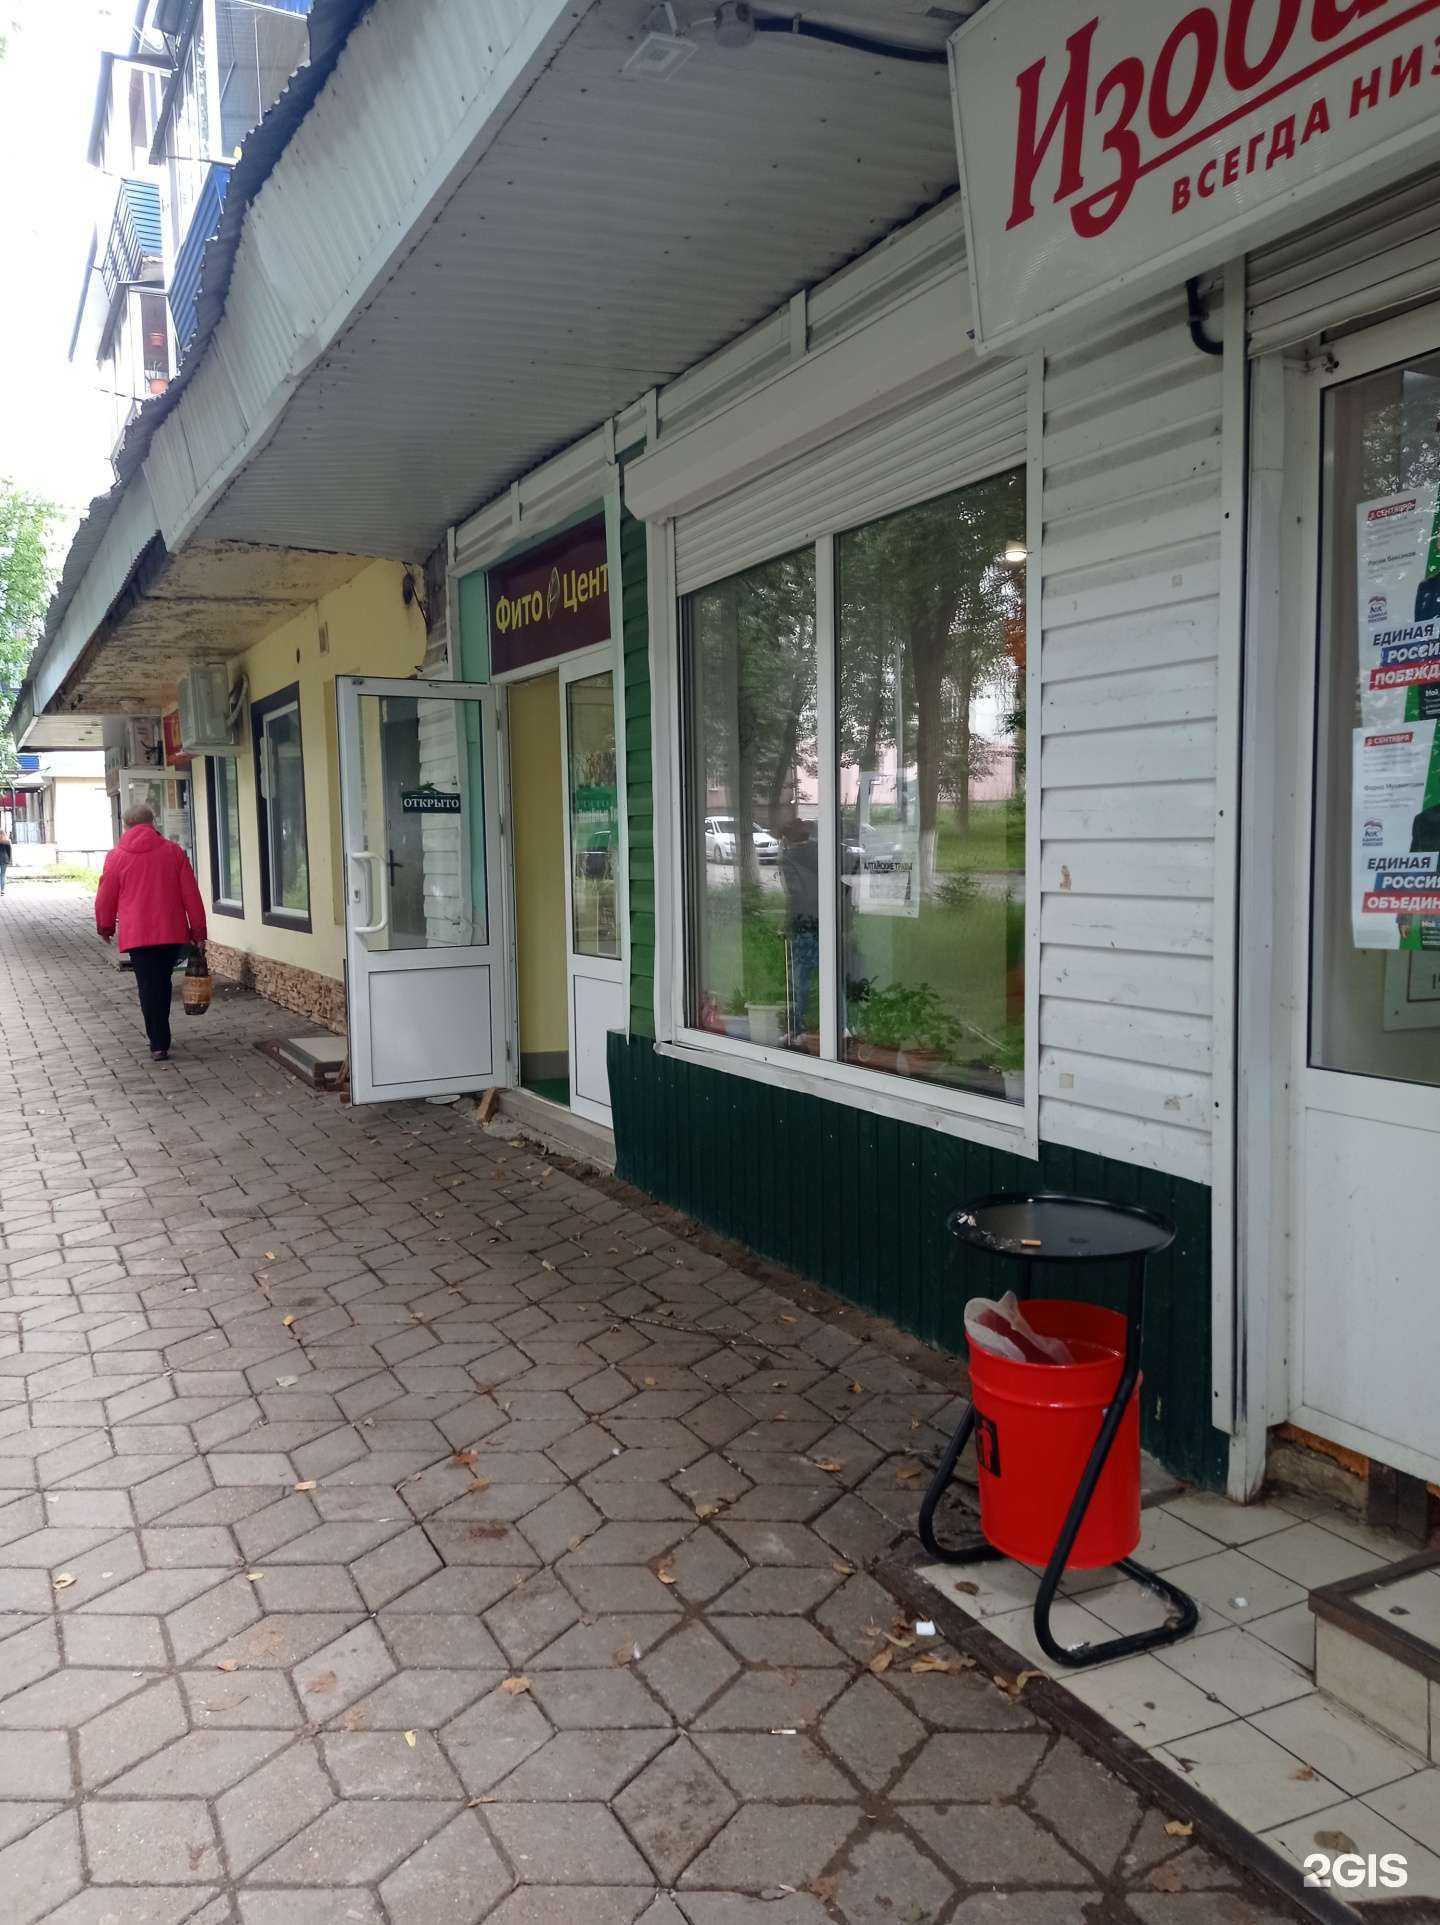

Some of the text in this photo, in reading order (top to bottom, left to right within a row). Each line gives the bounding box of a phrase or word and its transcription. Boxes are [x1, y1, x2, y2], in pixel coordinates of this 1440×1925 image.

[1172, 97, 1331, 215] ВСЕГДА
[496, 591, 543, 634] Фито
[1373, 624, 1434, 646] ЕДИНАЯ
[1387, 642, 1440, 663] РОССИ
[403, 798, 460, 808] ОТКРЫТО
[1367, 856, 1432, 871] ЕДИНАЯ
